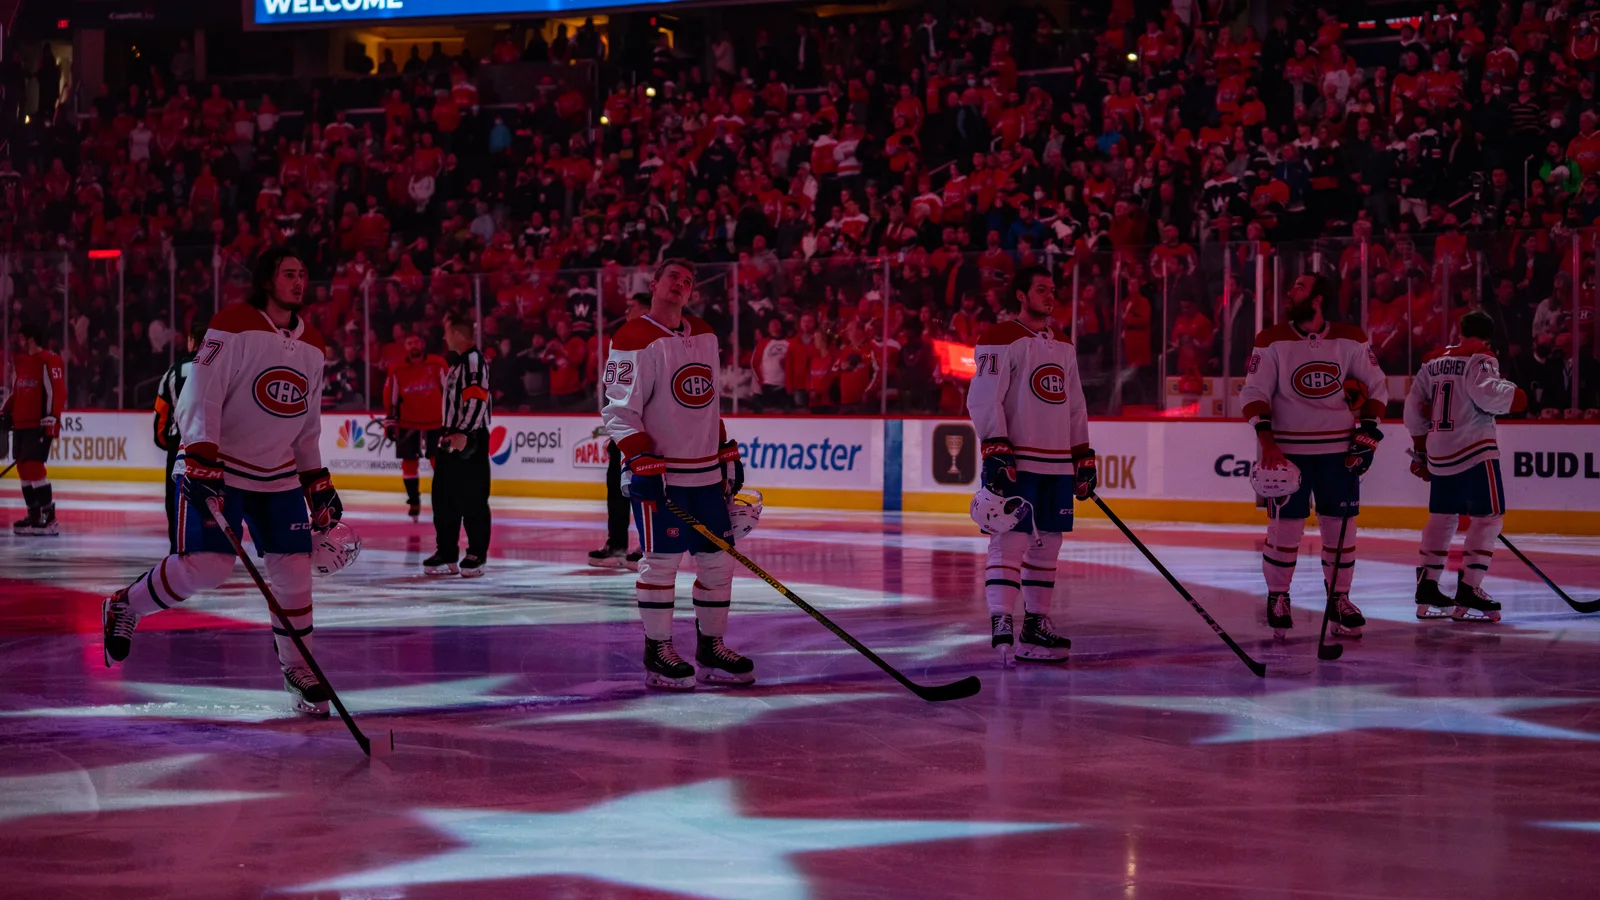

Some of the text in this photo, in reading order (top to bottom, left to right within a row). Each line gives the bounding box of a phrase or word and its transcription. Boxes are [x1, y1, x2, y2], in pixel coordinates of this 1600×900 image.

[604, 360, 634, 386] 62
[978, 353, 999, 377] 71
[60, 417, 83, 431] RS
[515, 428, 562, 453] pepsi
[575, 442, 599, 464] PAPA
[1514, 452, 1578, 478] BUD
[1214, 454, 1256, 477] Ca
[726, 545, 782, 593] SHERWOOD
